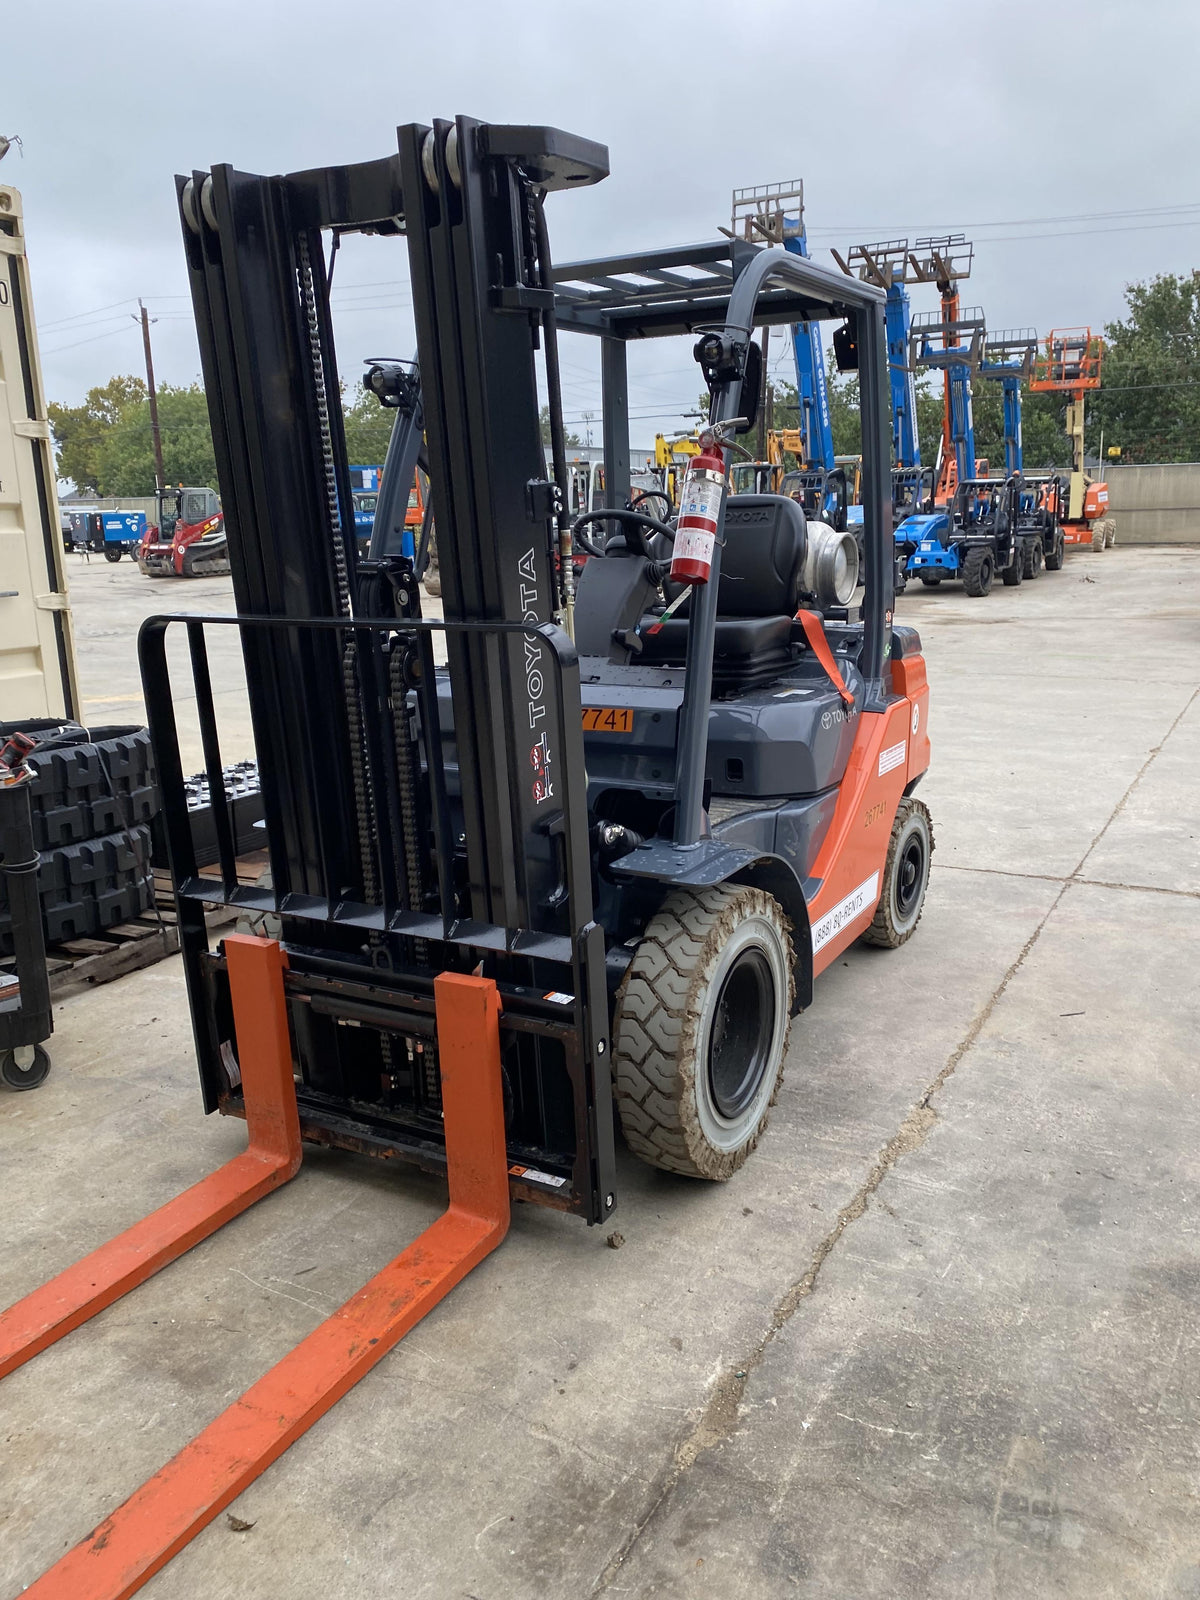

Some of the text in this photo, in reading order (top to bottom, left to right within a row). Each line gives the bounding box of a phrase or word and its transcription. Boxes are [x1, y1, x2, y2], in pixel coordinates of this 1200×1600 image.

[813, 326, 821, 367] Genie
[814, 892, 863, 947] (888) 80-RENTS
